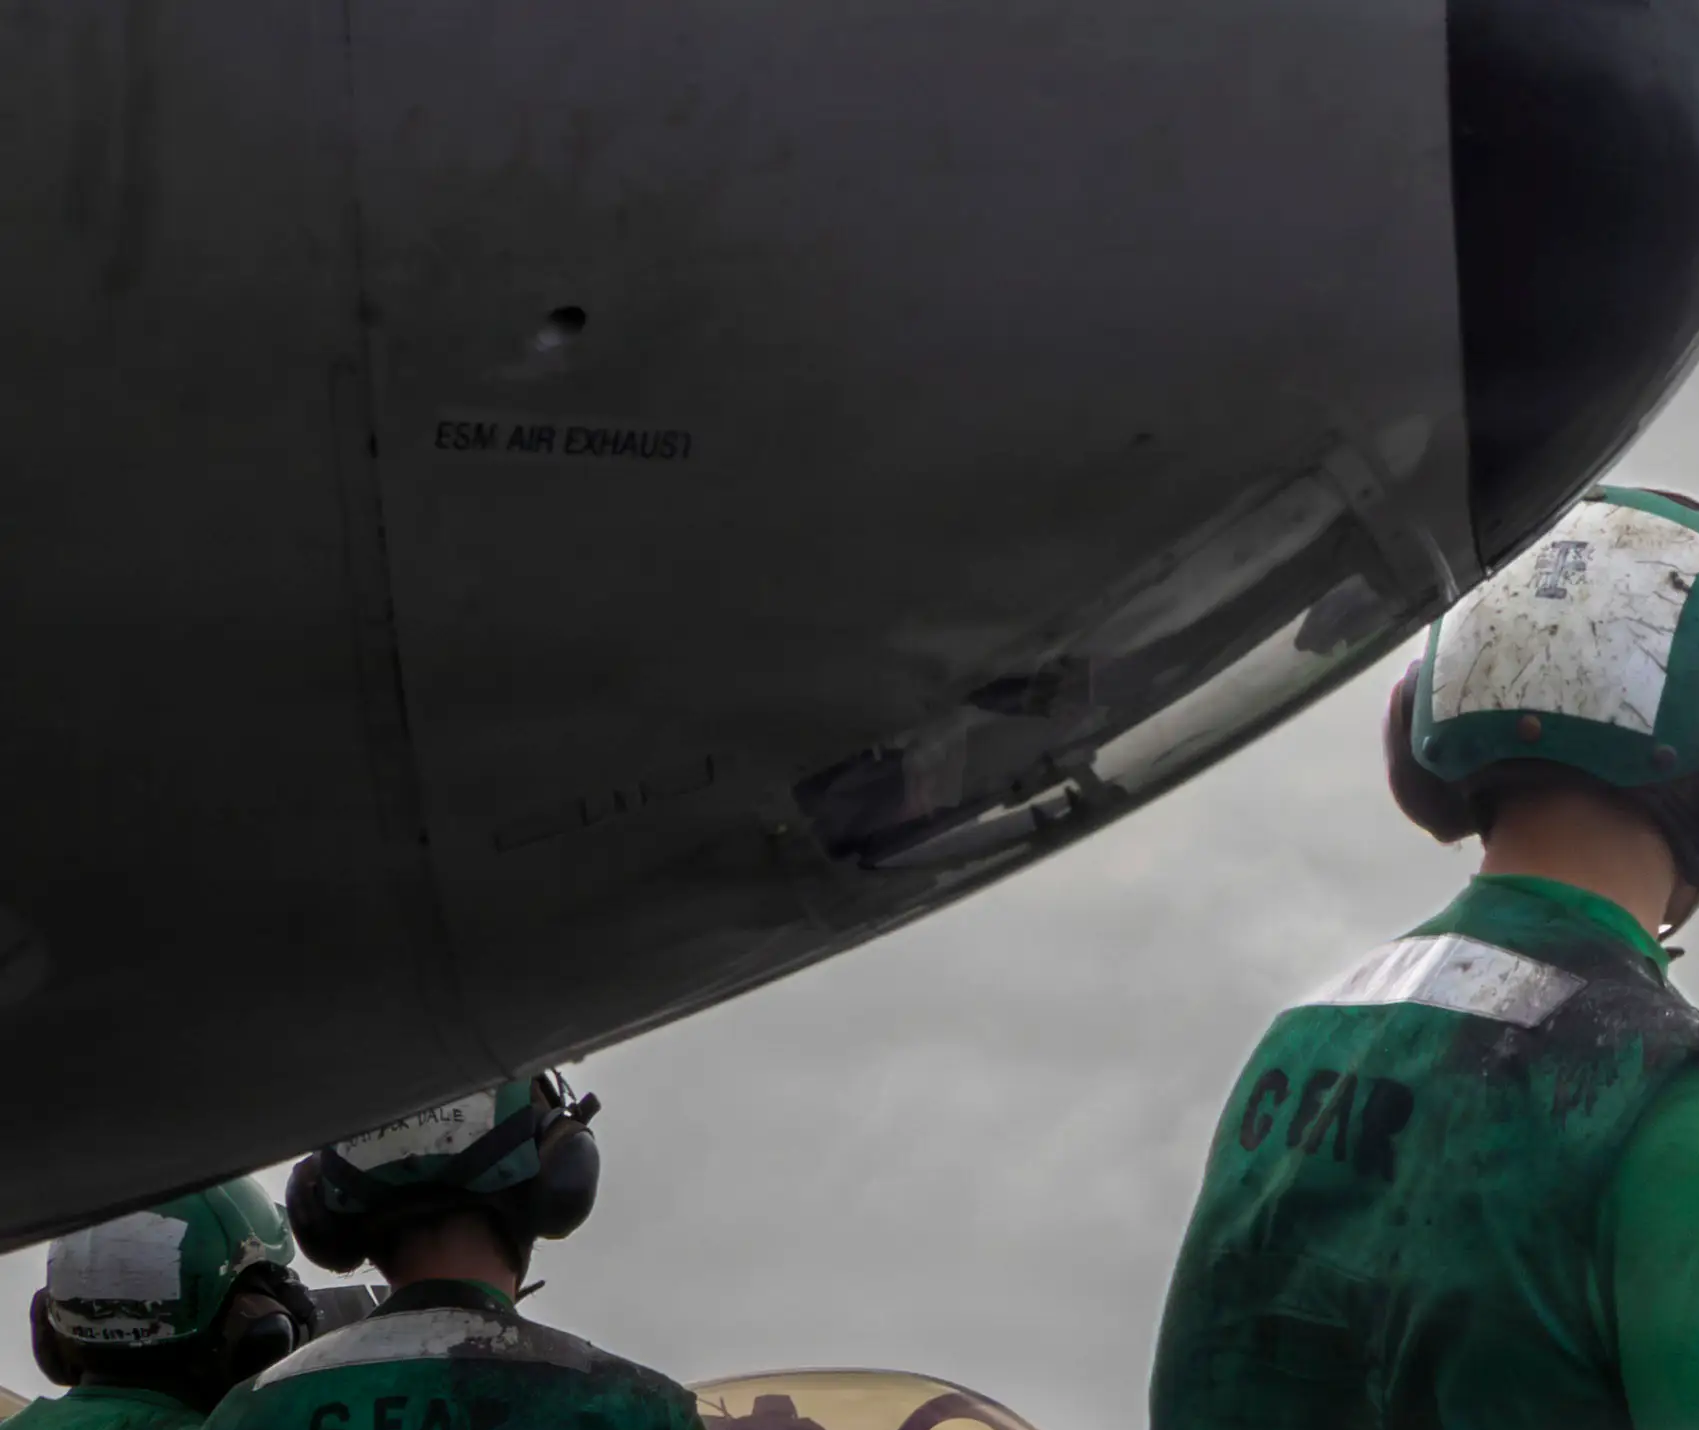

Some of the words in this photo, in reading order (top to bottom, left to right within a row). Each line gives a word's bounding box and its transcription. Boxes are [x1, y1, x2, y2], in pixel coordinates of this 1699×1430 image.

[434, 420, 498, 450] ESM
[506, 423, 556, 453] AIR
[565, 426, 692, 459] EXHAUST
